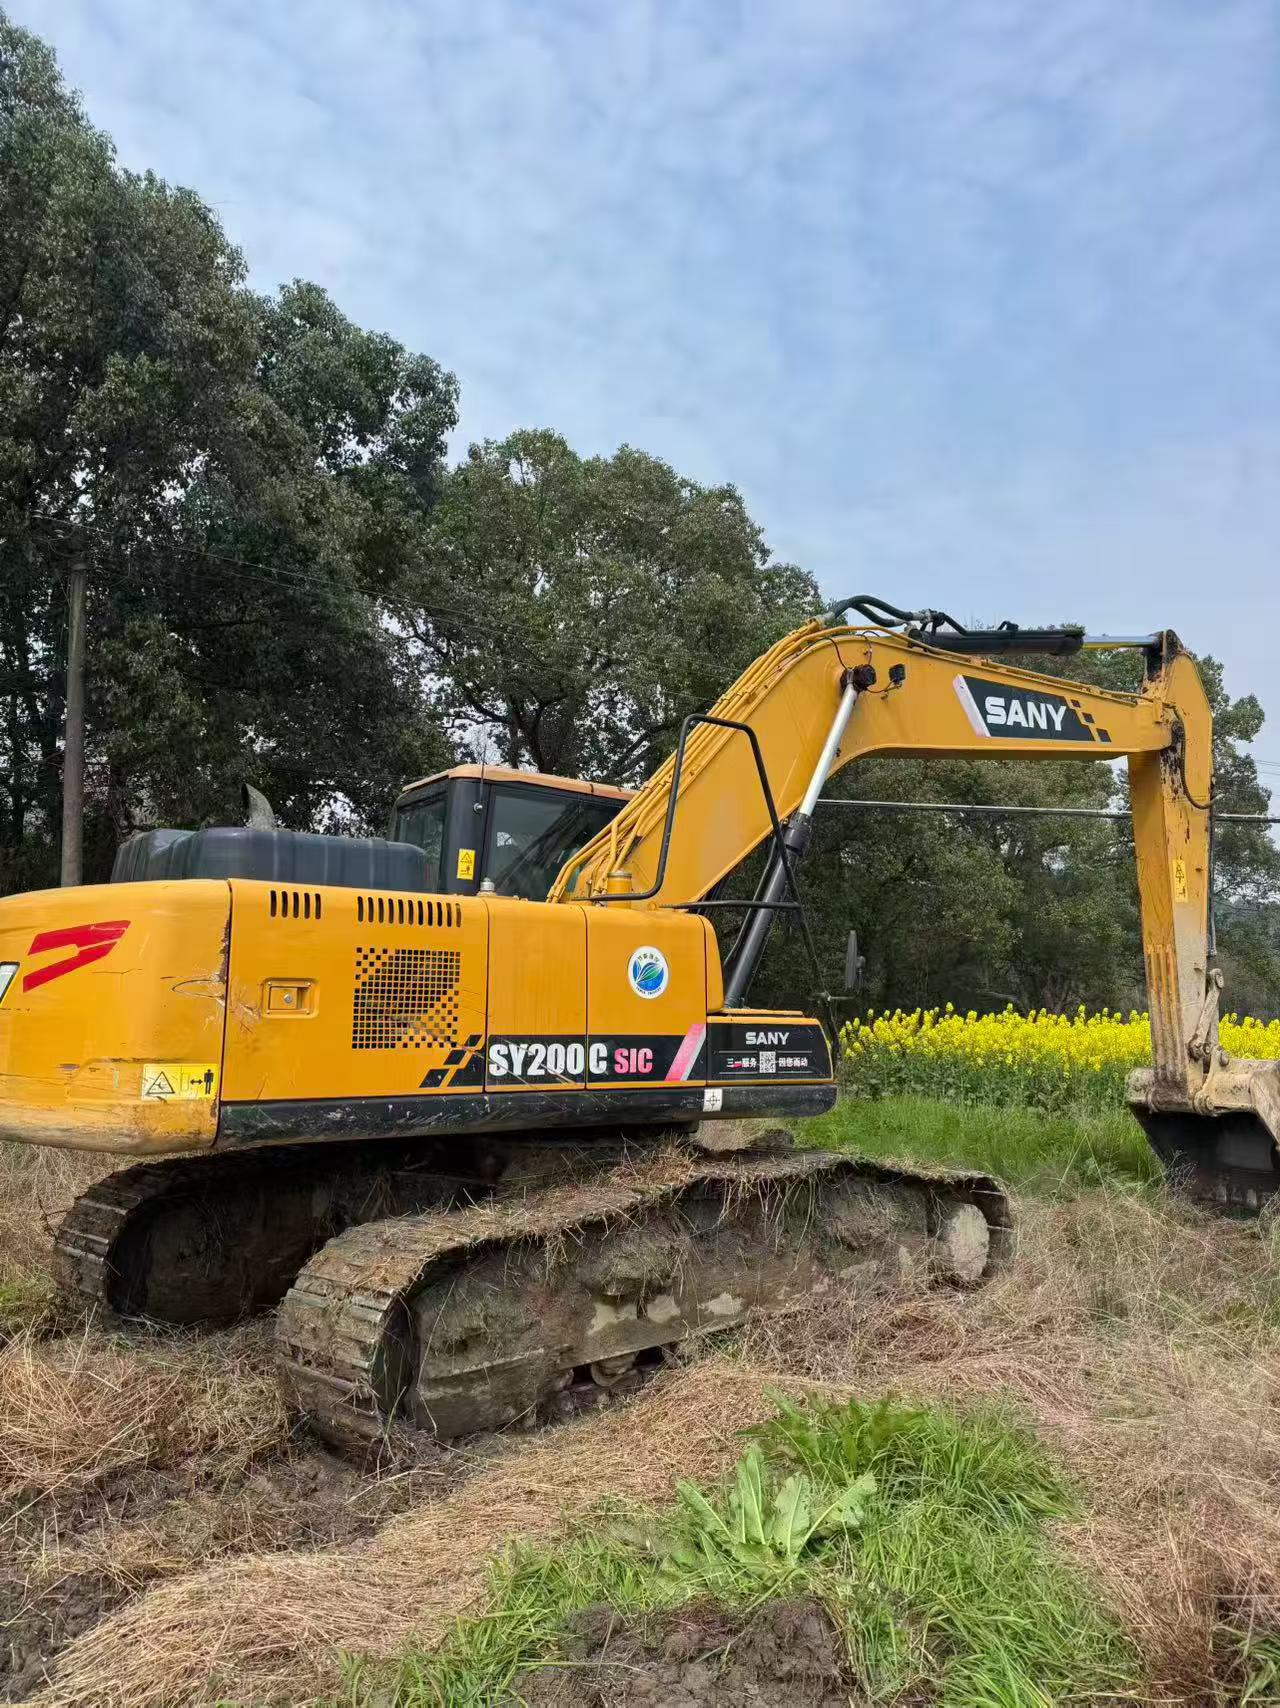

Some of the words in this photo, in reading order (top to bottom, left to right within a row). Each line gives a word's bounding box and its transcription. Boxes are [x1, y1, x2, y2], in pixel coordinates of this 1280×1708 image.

[985, 696, 1066, 731] SANY
[745, 1031, 790, 1045] SANY
[614, 1048, 653, 1074] SIC
